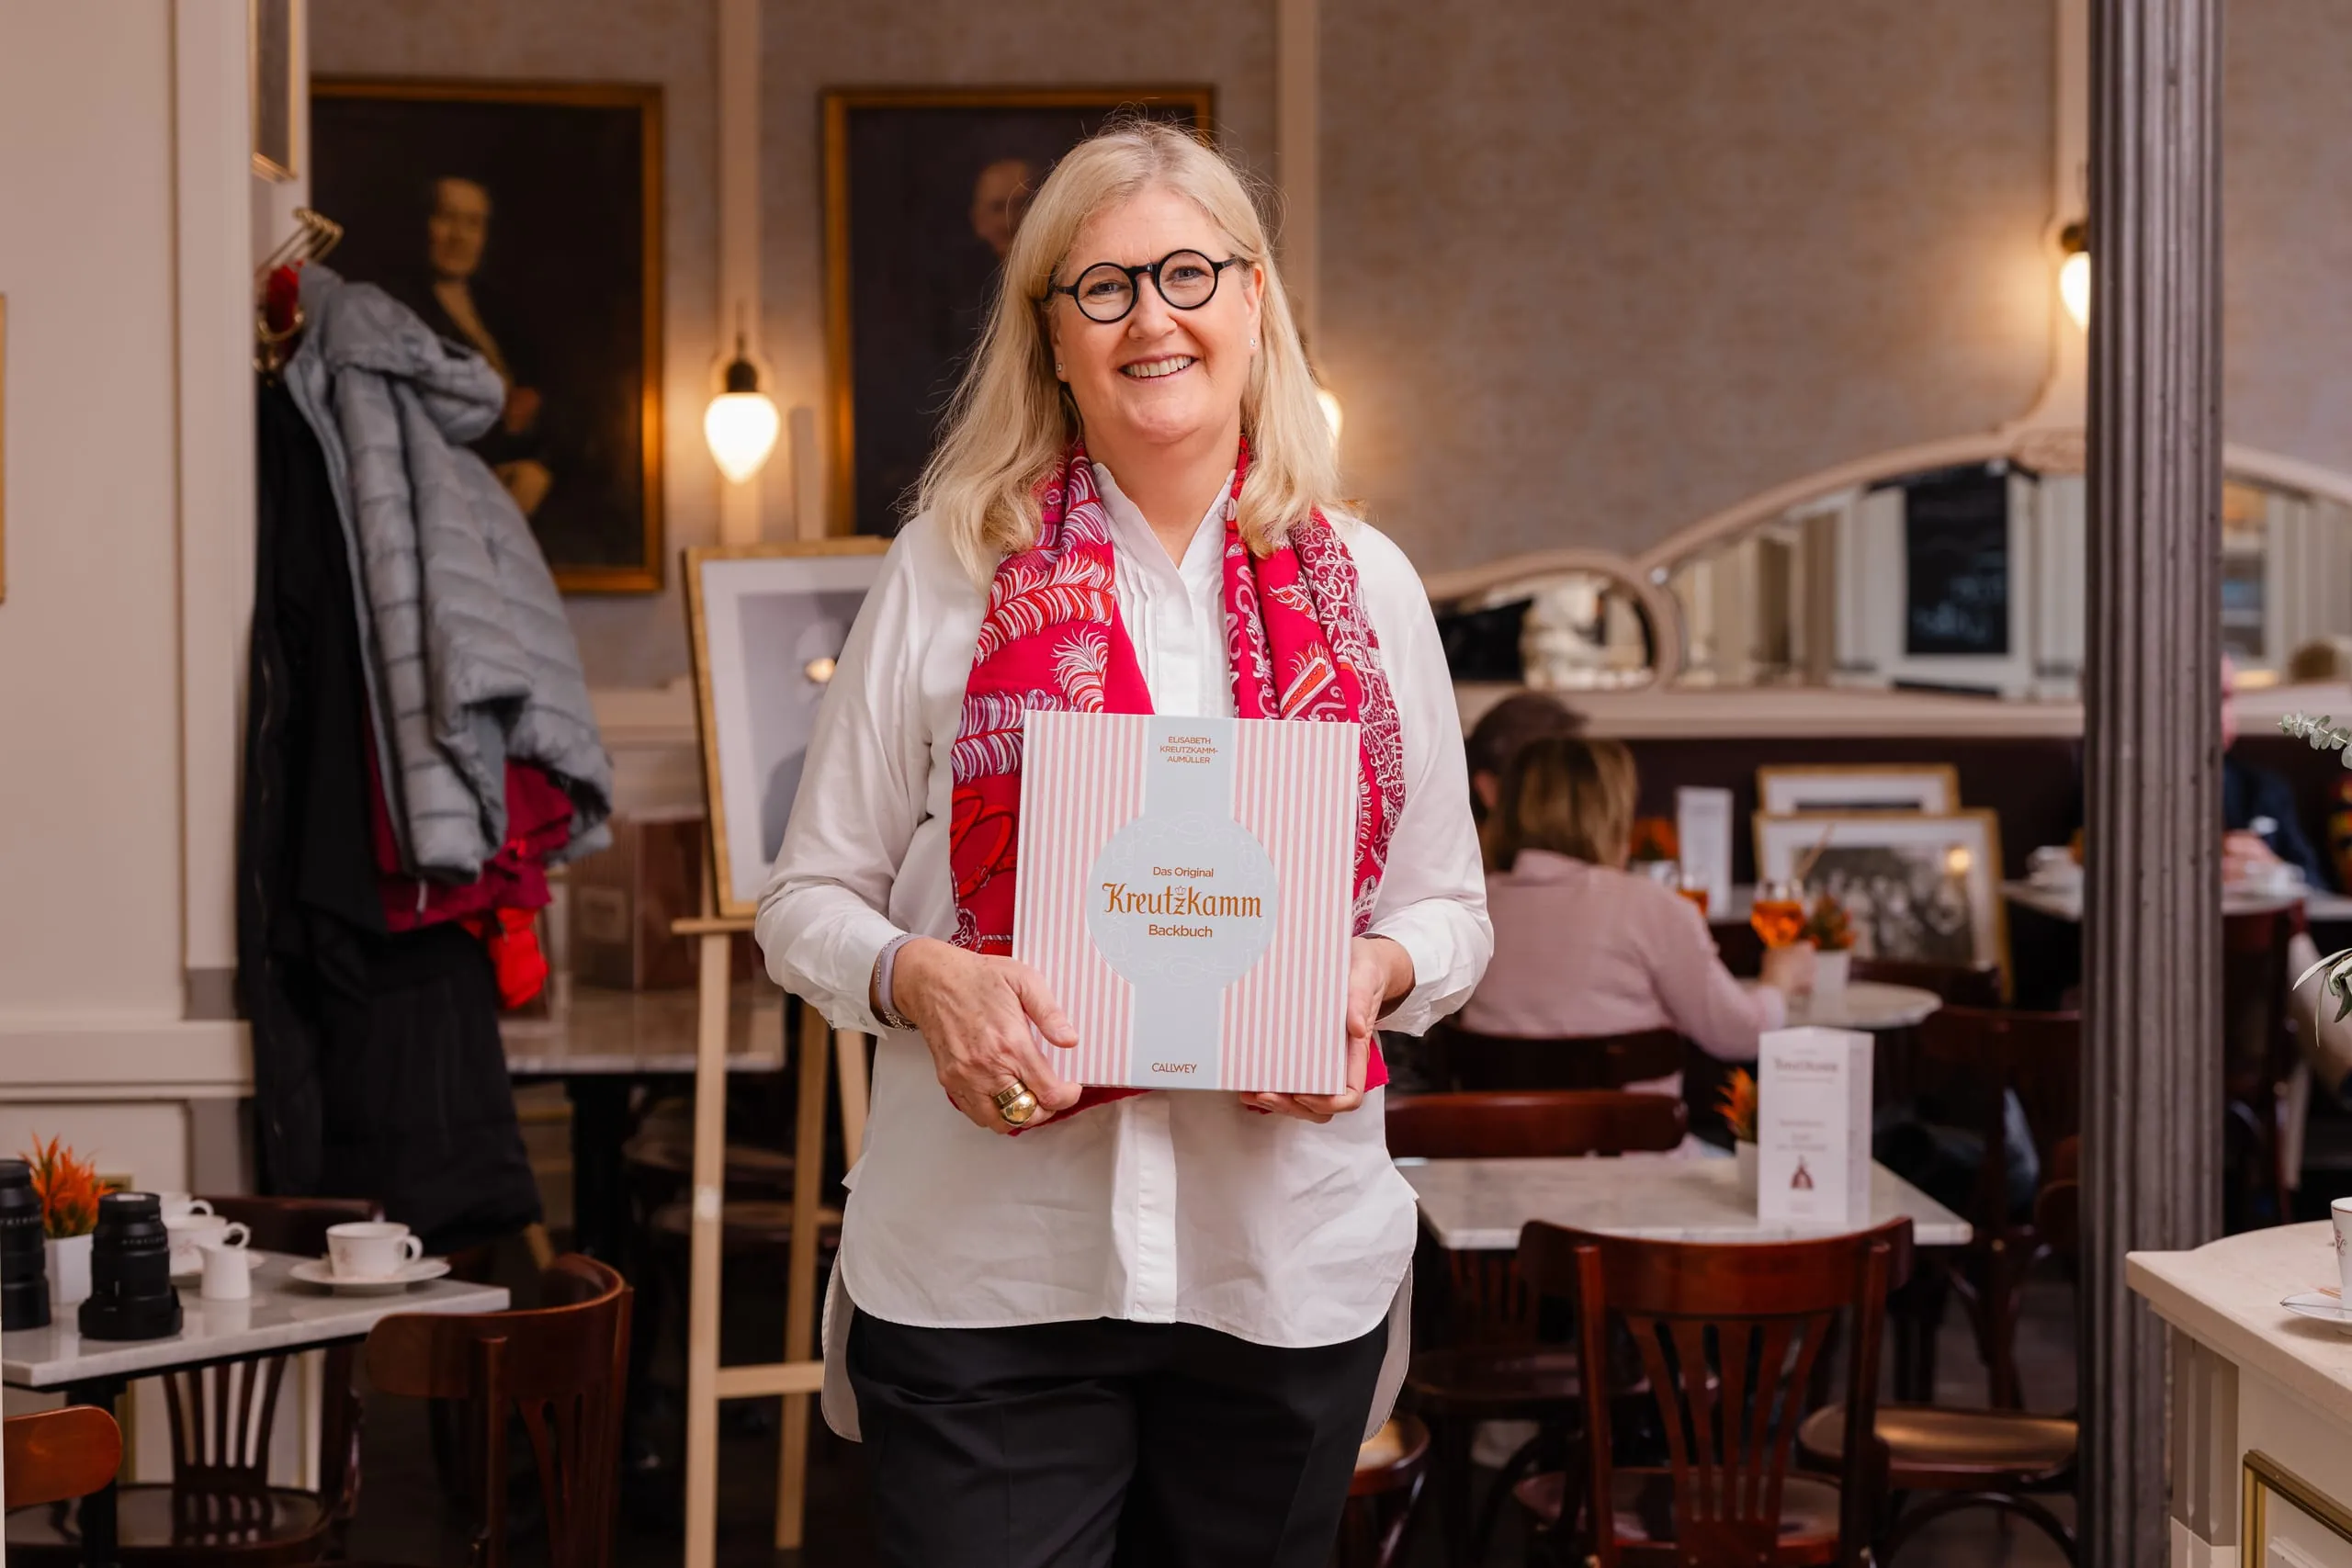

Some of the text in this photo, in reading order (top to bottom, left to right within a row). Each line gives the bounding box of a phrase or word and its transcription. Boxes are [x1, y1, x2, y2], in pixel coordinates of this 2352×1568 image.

[1168, 736, 1212, 744] ELISABETH
[1159, 745, 1218, 755] KREUTZKAMM-
[1152, 866, 1215, 879] Das Original
[1102, 882, 1263, 919] Kreutzkamm
[1148, 923, 1214, 939] Backbuch
[1151, 1062, 1198, 1074] CALLWEY
